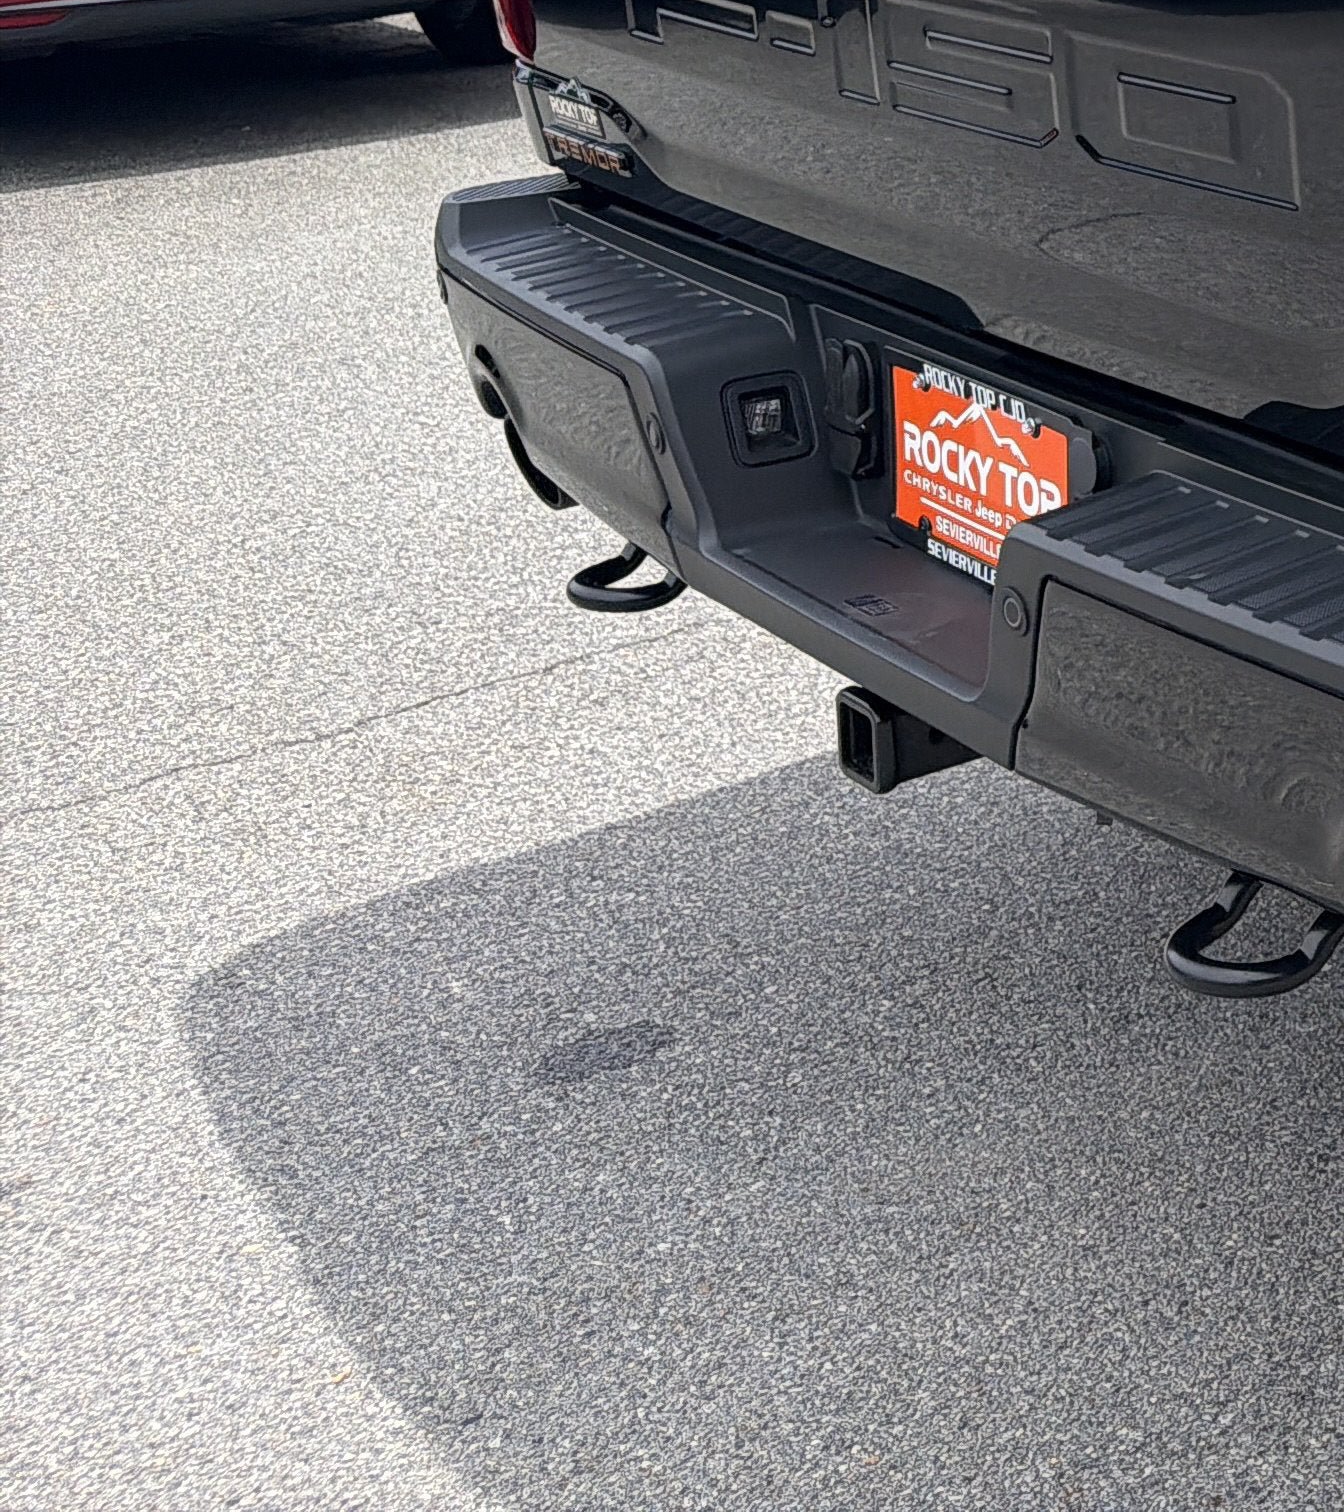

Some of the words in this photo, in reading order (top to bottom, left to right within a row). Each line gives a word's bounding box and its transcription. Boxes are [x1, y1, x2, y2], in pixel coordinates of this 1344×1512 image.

[549, 95, 579, 120] ROCKY
[545, 131, 622, 176] TREMOR
[923, 363, 965, 400] ROCKY
[969, 381, 996, 410] TOP
[1000, 396, 1026, 423] CJD
[903, 420, 994, 497] ROCKY
[998, 462, 1062, 517] TOP
[903, 469, 972, 512] CHRYSLER
[975, 499, 1003, 529] Jeep
